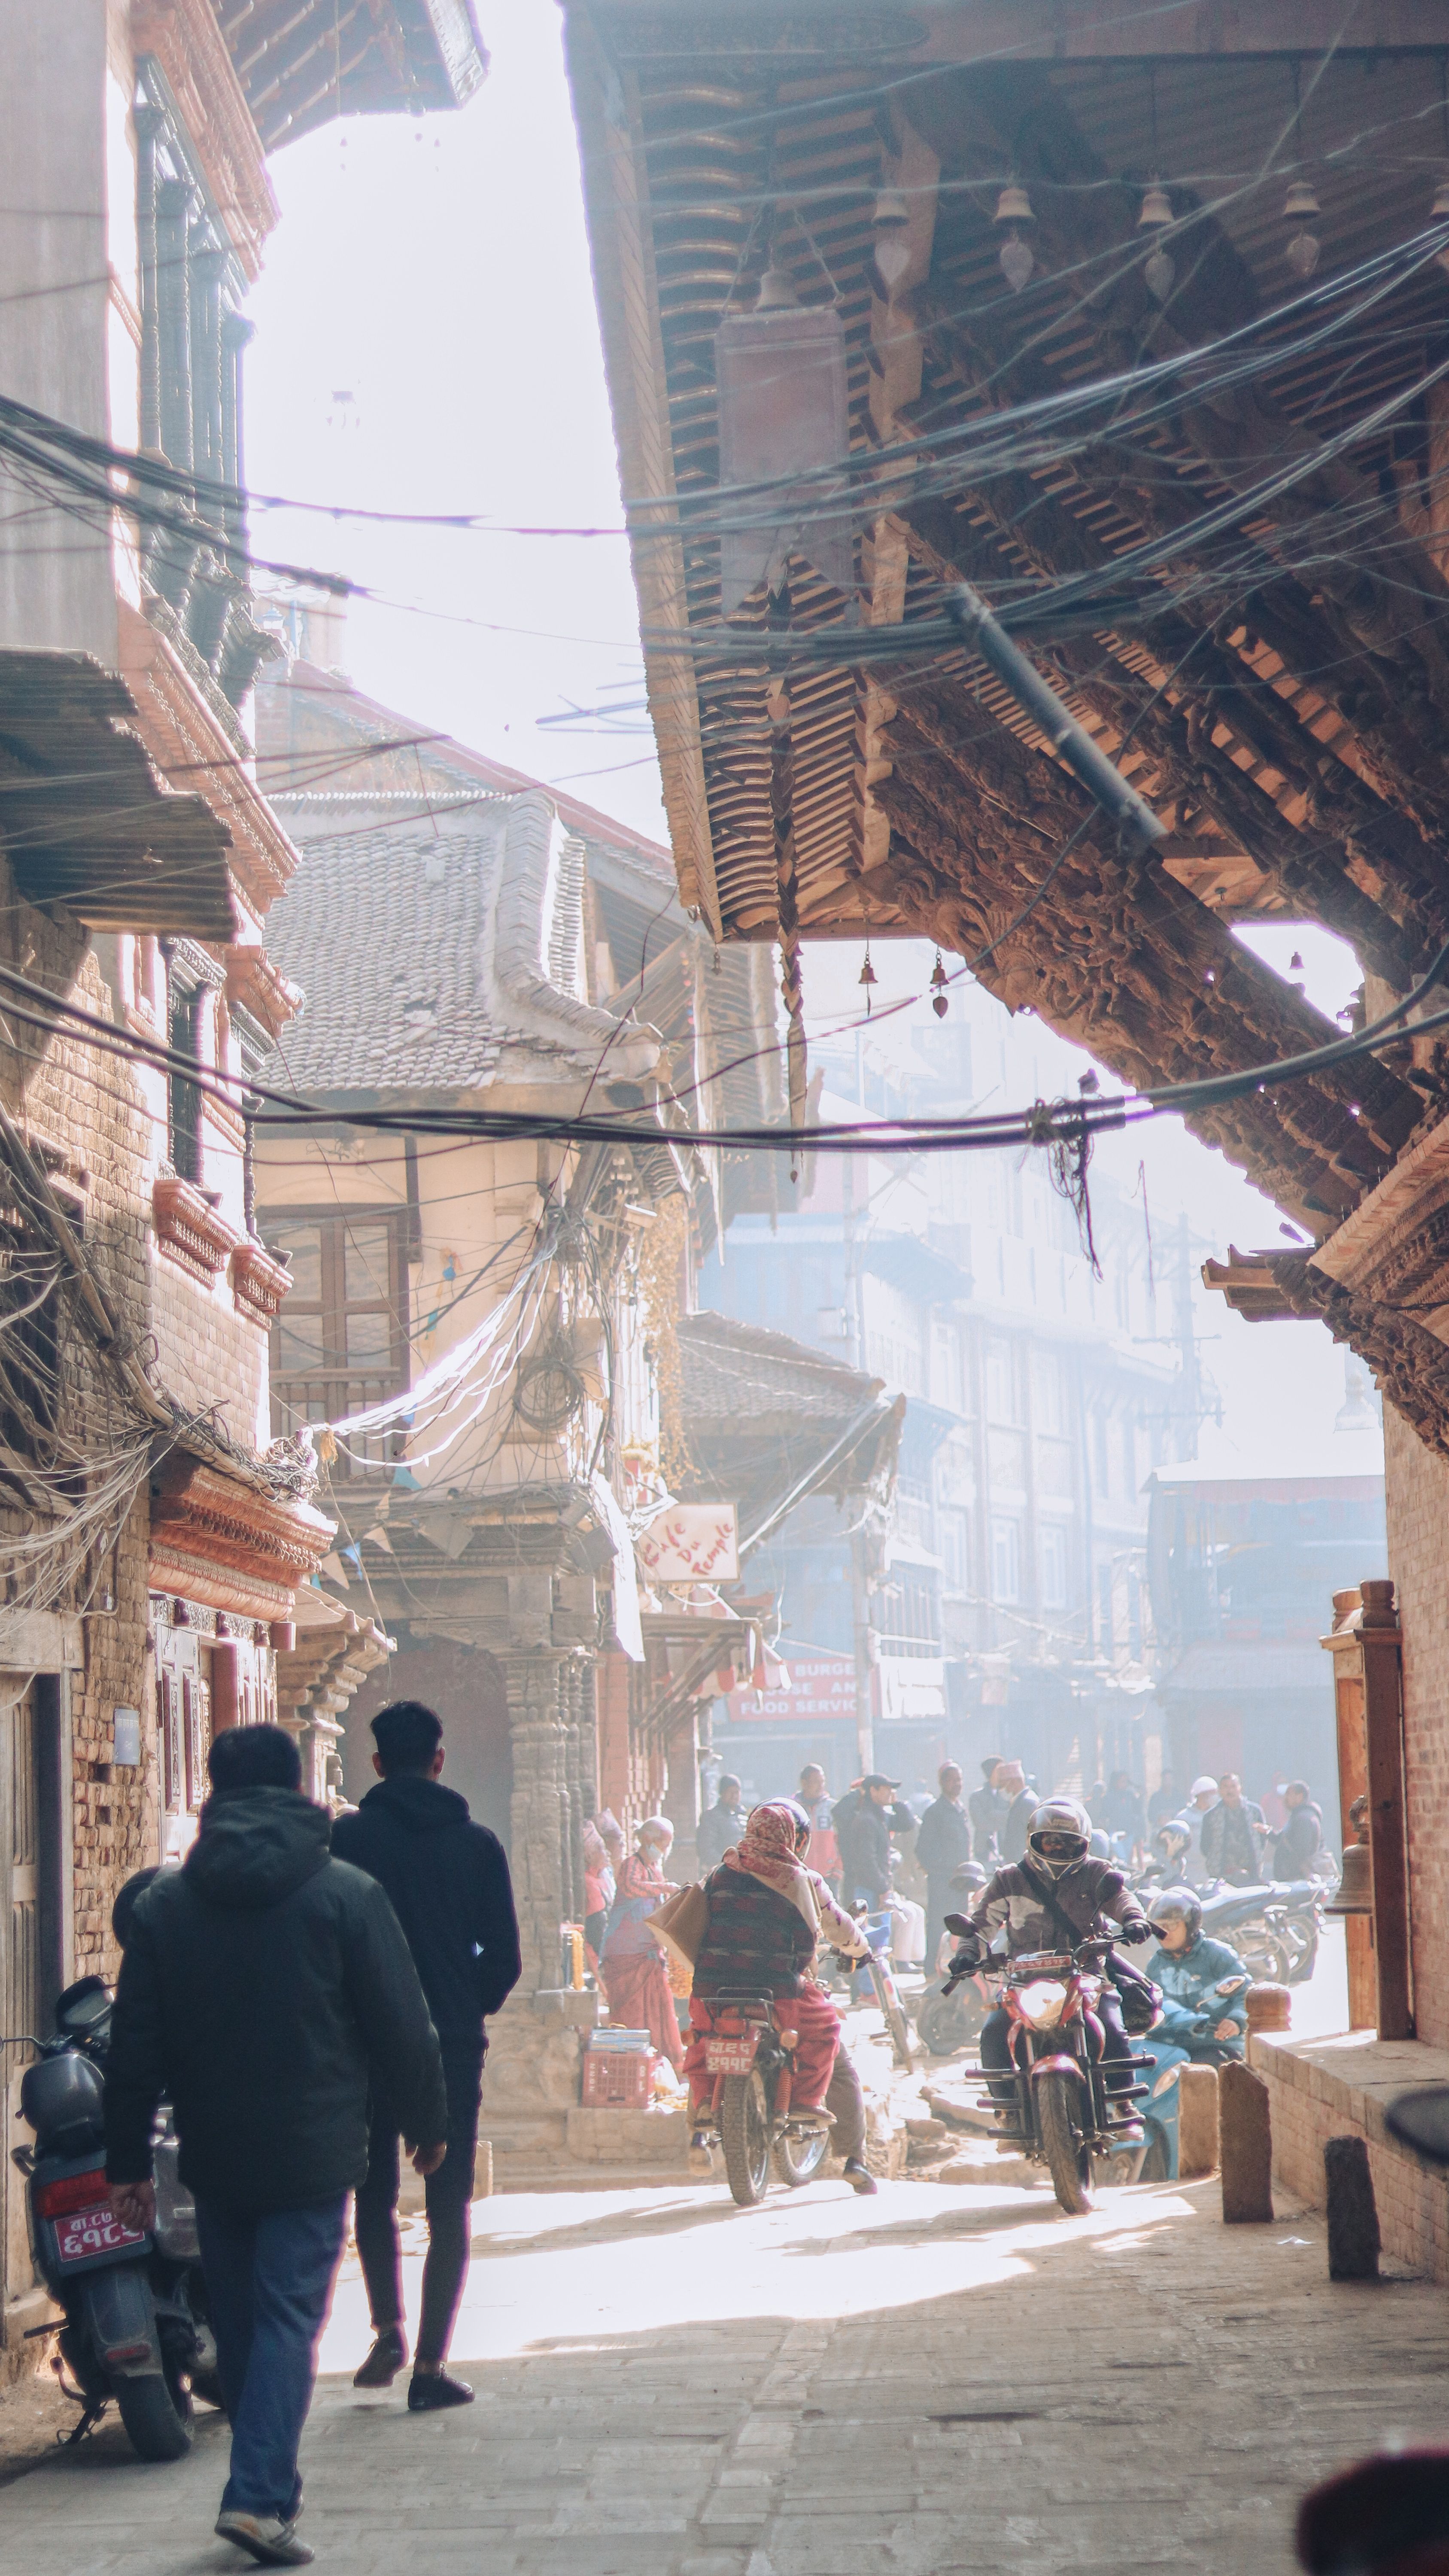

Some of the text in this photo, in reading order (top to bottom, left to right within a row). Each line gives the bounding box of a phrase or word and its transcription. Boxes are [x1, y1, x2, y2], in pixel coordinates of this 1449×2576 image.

[691, 1523, 733, 1575] Temple
[795, 1662, 856, 1677] BURGE
[831, 1681, 856, 1693] AN
[740, 1698, 856, 1715] FOOD SERVIC
